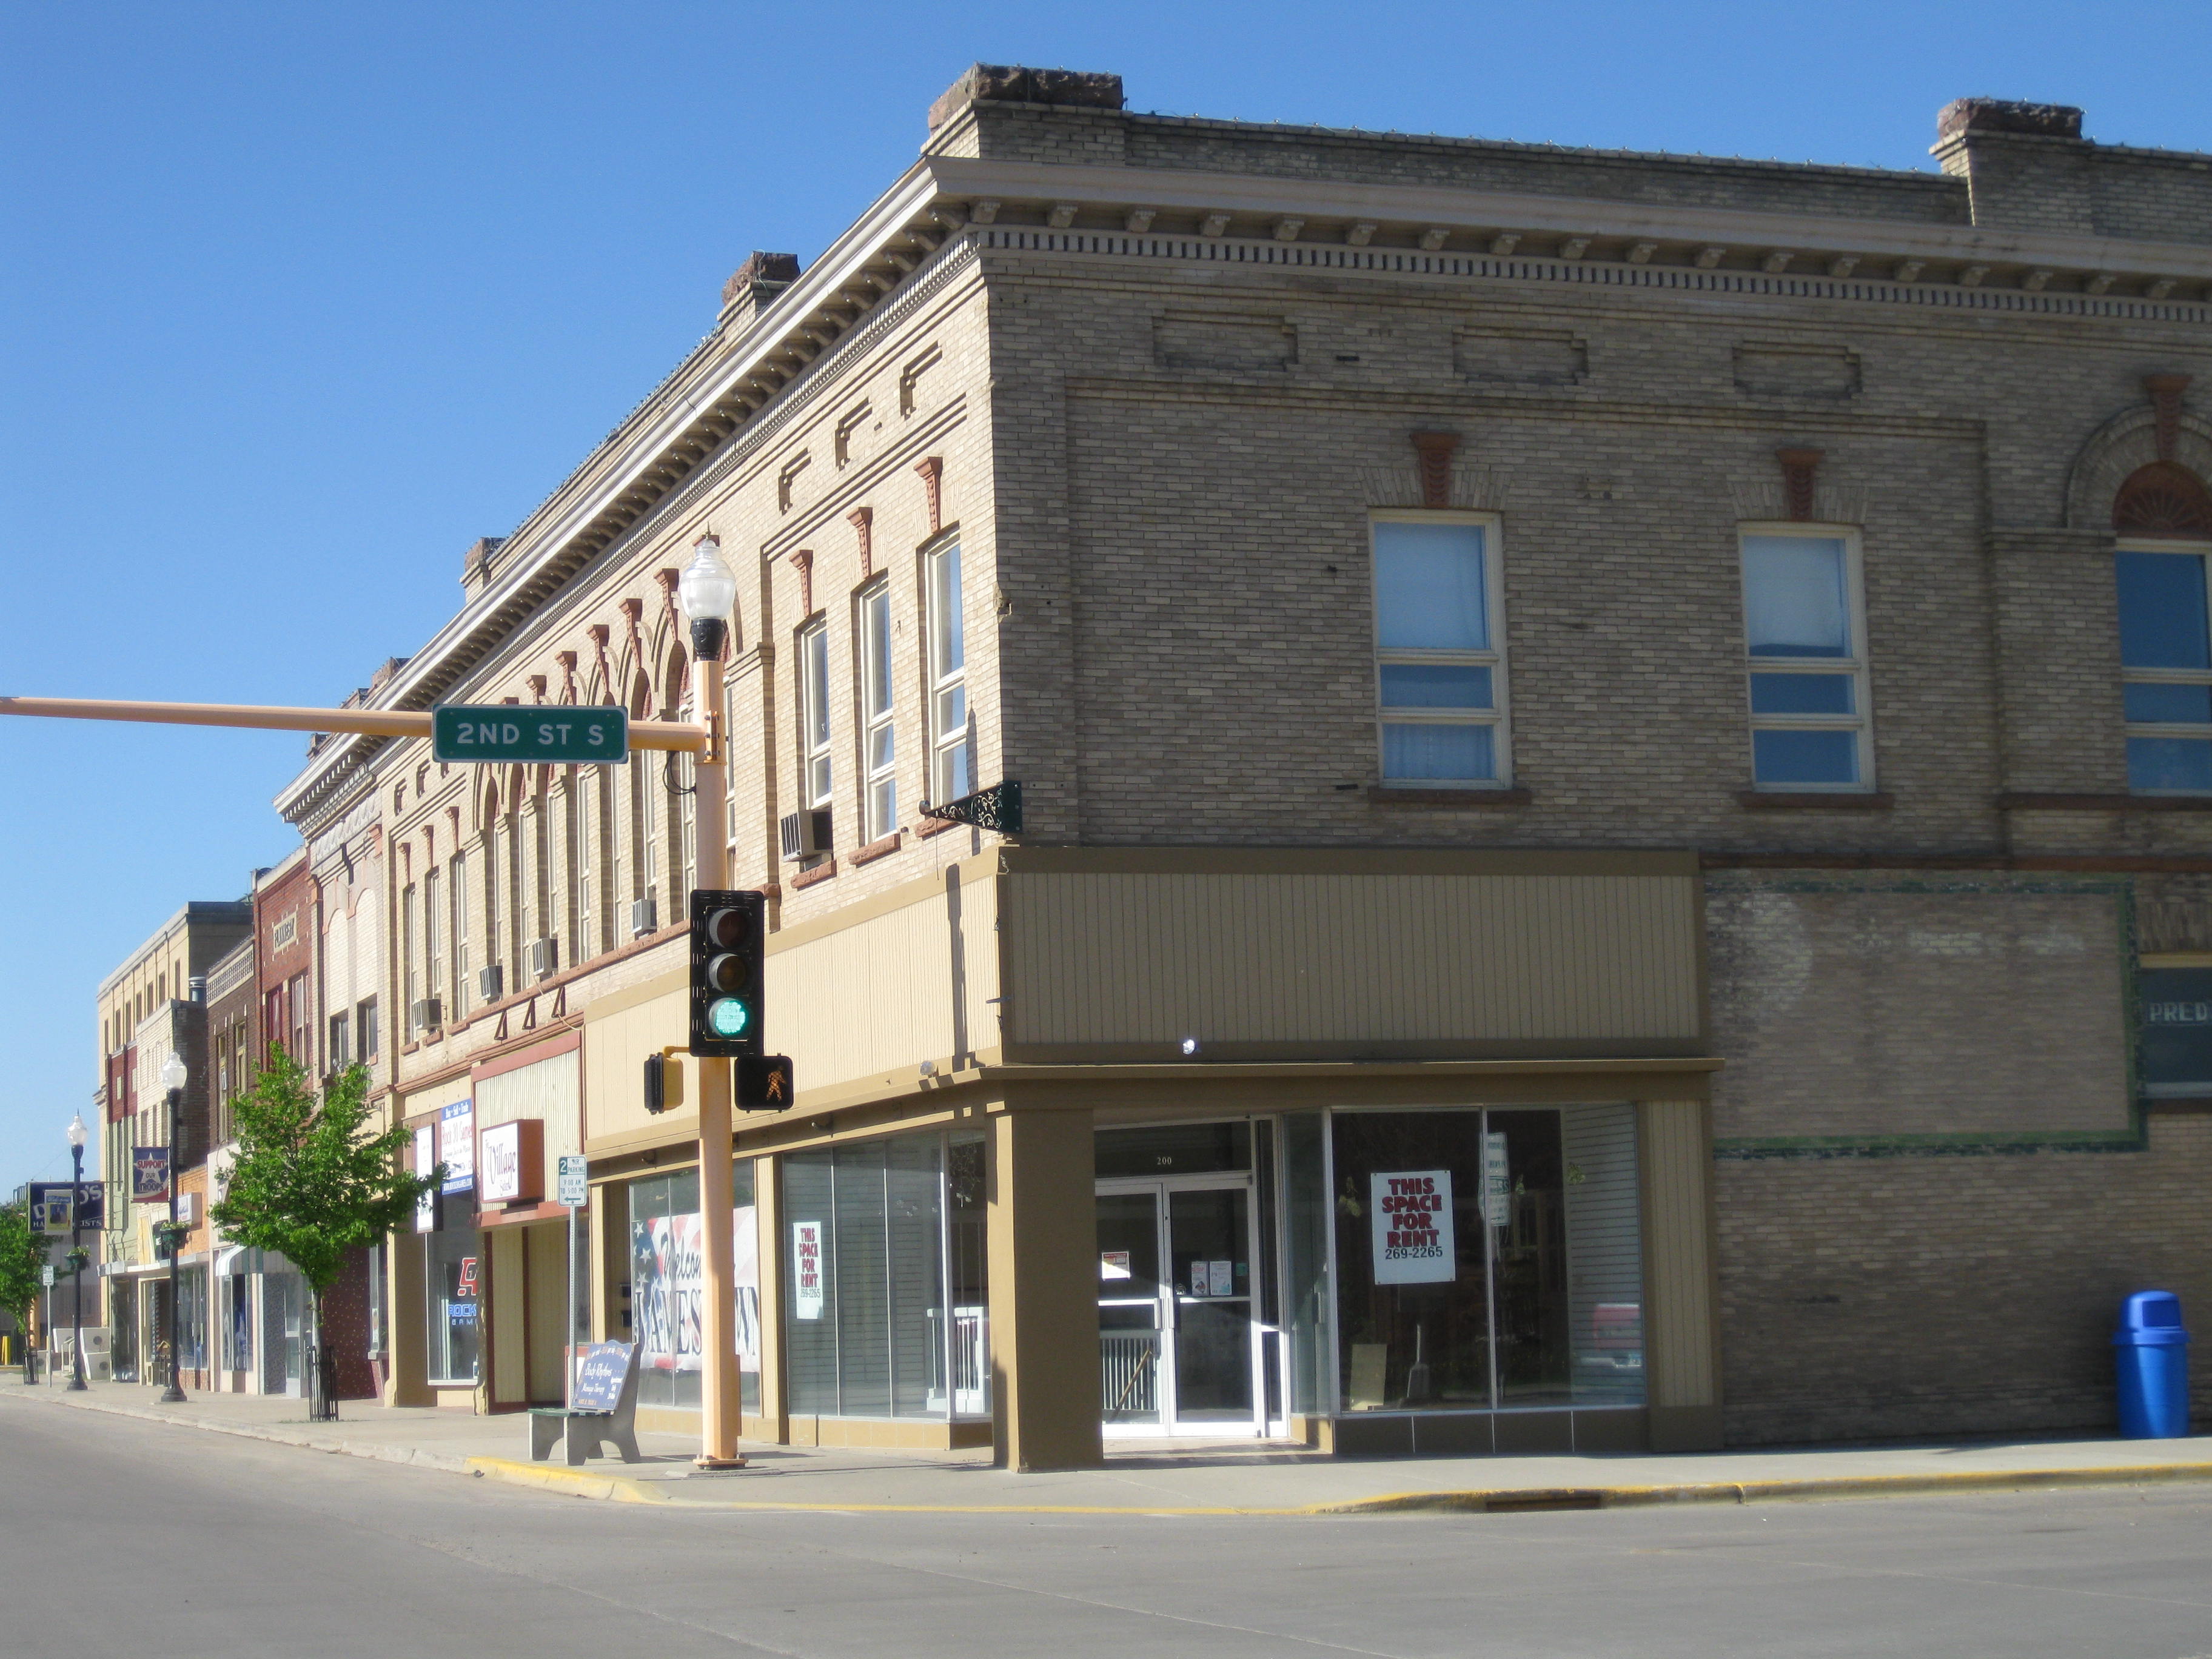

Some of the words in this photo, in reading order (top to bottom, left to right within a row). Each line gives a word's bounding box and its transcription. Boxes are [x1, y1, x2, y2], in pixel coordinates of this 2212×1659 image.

[457, 723, 520, 744] 2ND
[538, 723, 572, 745] ST
[588, 725, 604, 746] S
[137, 1159, 166, 1169] SUPPORT
[486, 1142, 516, 1190] Village
[560, 1160, 567, 1173] 2
[1158, 1156, 1172, 1165] 200
[139, 1182, 164, 1192] TROOPS
[1388, 1177, 1435, 1195] THIS
[1382, 1195, 1443, 1213] SPACE
[1392, 1213, 1432, 1230] FOR
[800, 1227, 816, 1242] THIS
[1387, 1229, 1439, 1248] RENT
[799, 1242, 819, 1258] SPACE
[1385, 1247, 1443, 1259] 269-2265
[802, 1258, 816, 1273] FOR
[800, 1273, 819, 1288] RENT
[800, 1288, 820, 1298] 269-2265
[448, 1304, 477, 1317] ROCK
[635, 1287, 759, 1356] JAMESWN
